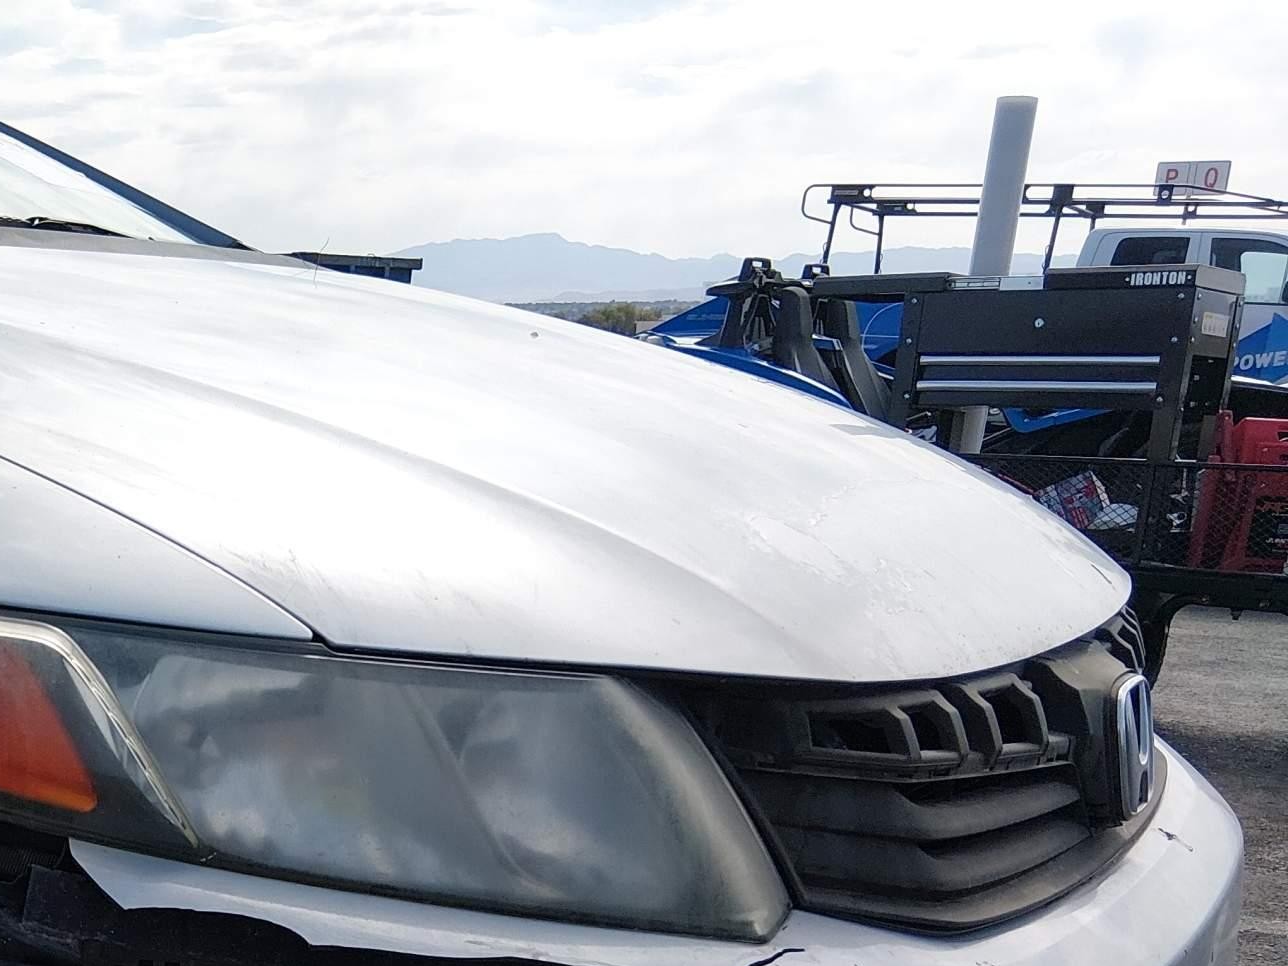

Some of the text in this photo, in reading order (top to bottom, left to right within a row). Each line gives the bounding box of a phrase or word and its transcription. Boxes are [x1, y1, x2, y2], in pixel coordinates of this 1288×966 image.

[1165, 168, 1179, 184] P
[1204, 167, 1219, 188] Q
[1130, 271, 1187, 286] IRONTON
